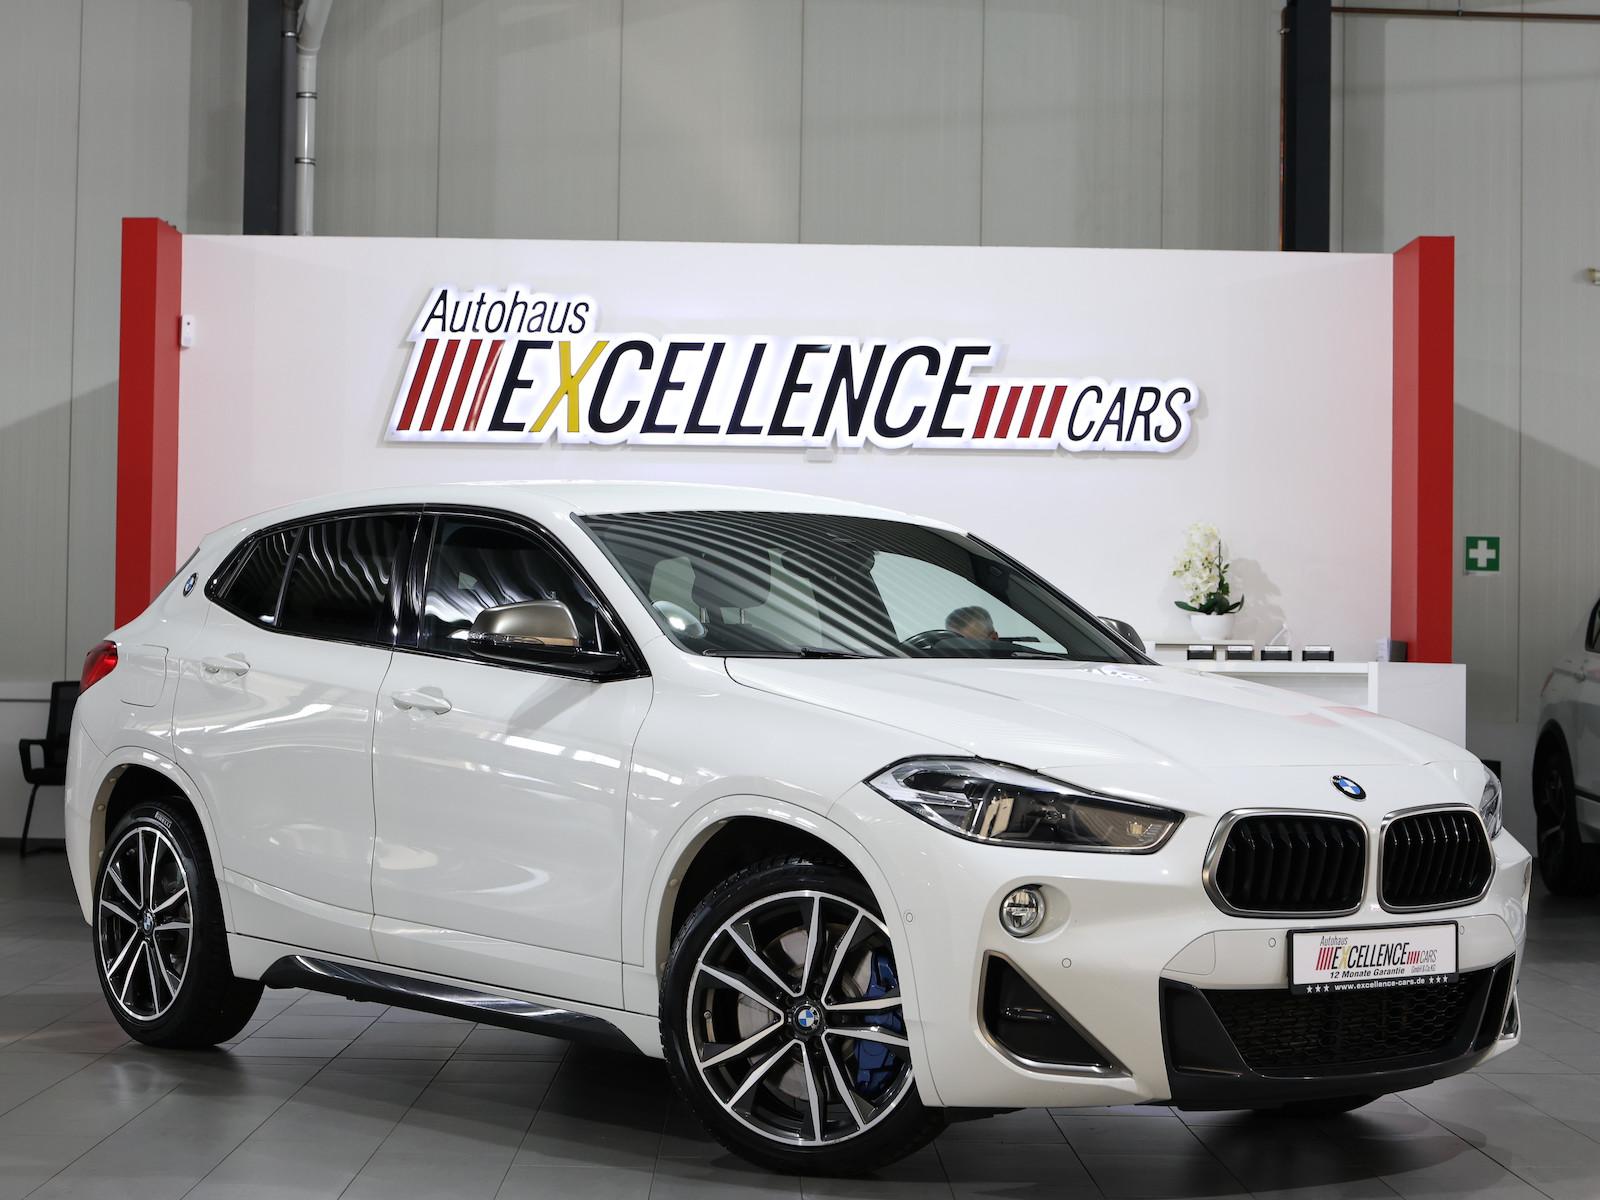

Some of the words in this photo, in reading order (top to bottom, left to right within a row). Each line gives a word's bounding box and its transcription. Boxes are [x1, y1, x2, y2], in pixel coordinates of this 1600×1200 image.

[421, 289, 590, 334] Autohaus
[487, 339, 991, 439] EXCELLENCE
[1067, 384, 1192, 443] CARS
[1320, 935, 1349, 947] Autohaus
[1331, 942, 1410, 970] EXCELLENCE
[1420, 949, 1438, 964] CARS
[1330, 971, 1340, 979] 12
[1341, 970, 1371, 979] Monate
[1373, 967, 1405, 977] Garantie
[1334, 977, 1425, 990] www.excellence-cars.de
